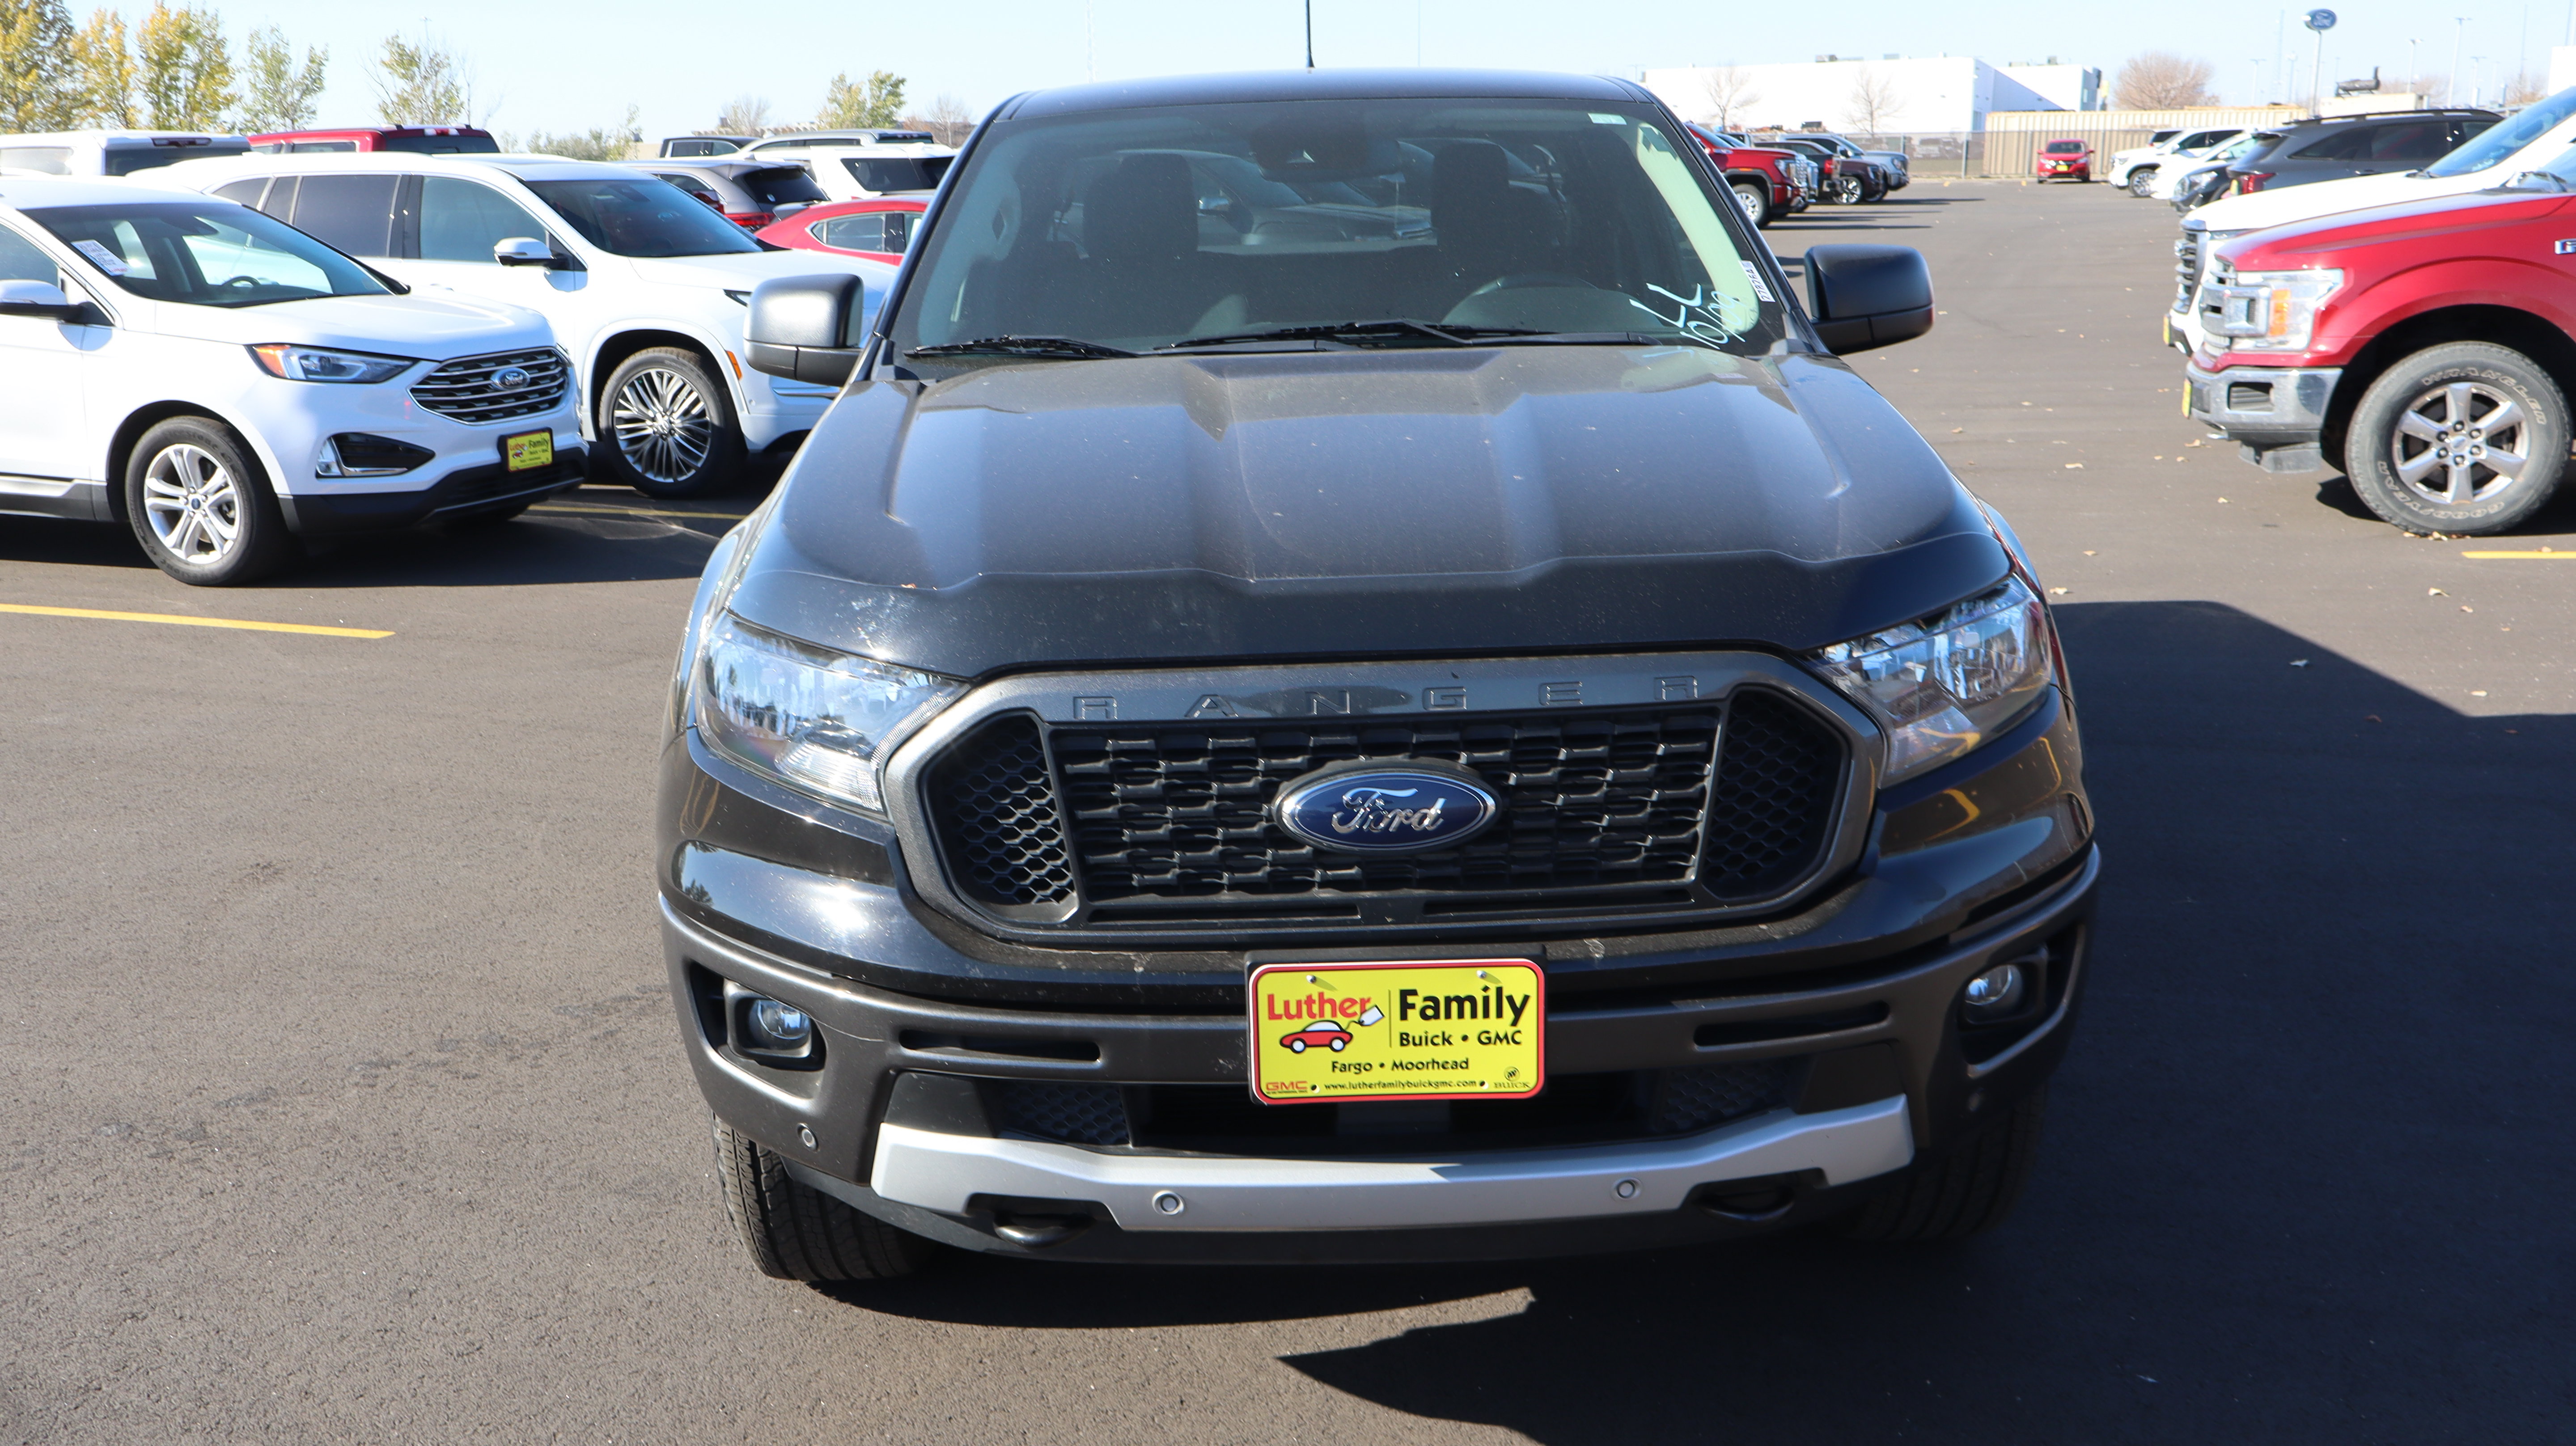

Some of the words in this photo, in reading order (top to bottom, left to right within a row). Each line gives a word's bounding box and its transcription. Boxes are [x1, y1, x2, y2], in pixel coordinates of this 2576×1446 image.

[2422, 367, 2546, 424] WRANGLER
[1073, 675, 1698, 719] RANGER
[1331, 787, 1446, 834] Ford
[1267, 992, 1372, 1020] Luther
[1399, 985, 1531, 1026] Family
[1400, 1030, 1453, 1047] Buick
[1477, 1030, 1522, 1045] GMC
[1331, 1061, 1373, 1074] Fargo
[1391, 1058, 1469, 1071] Moorhead
[1266, 1081, 1308, 1090] GMC
[1324, 1079, 1476, 1090] www.lutherfamilybuickgmc.com
